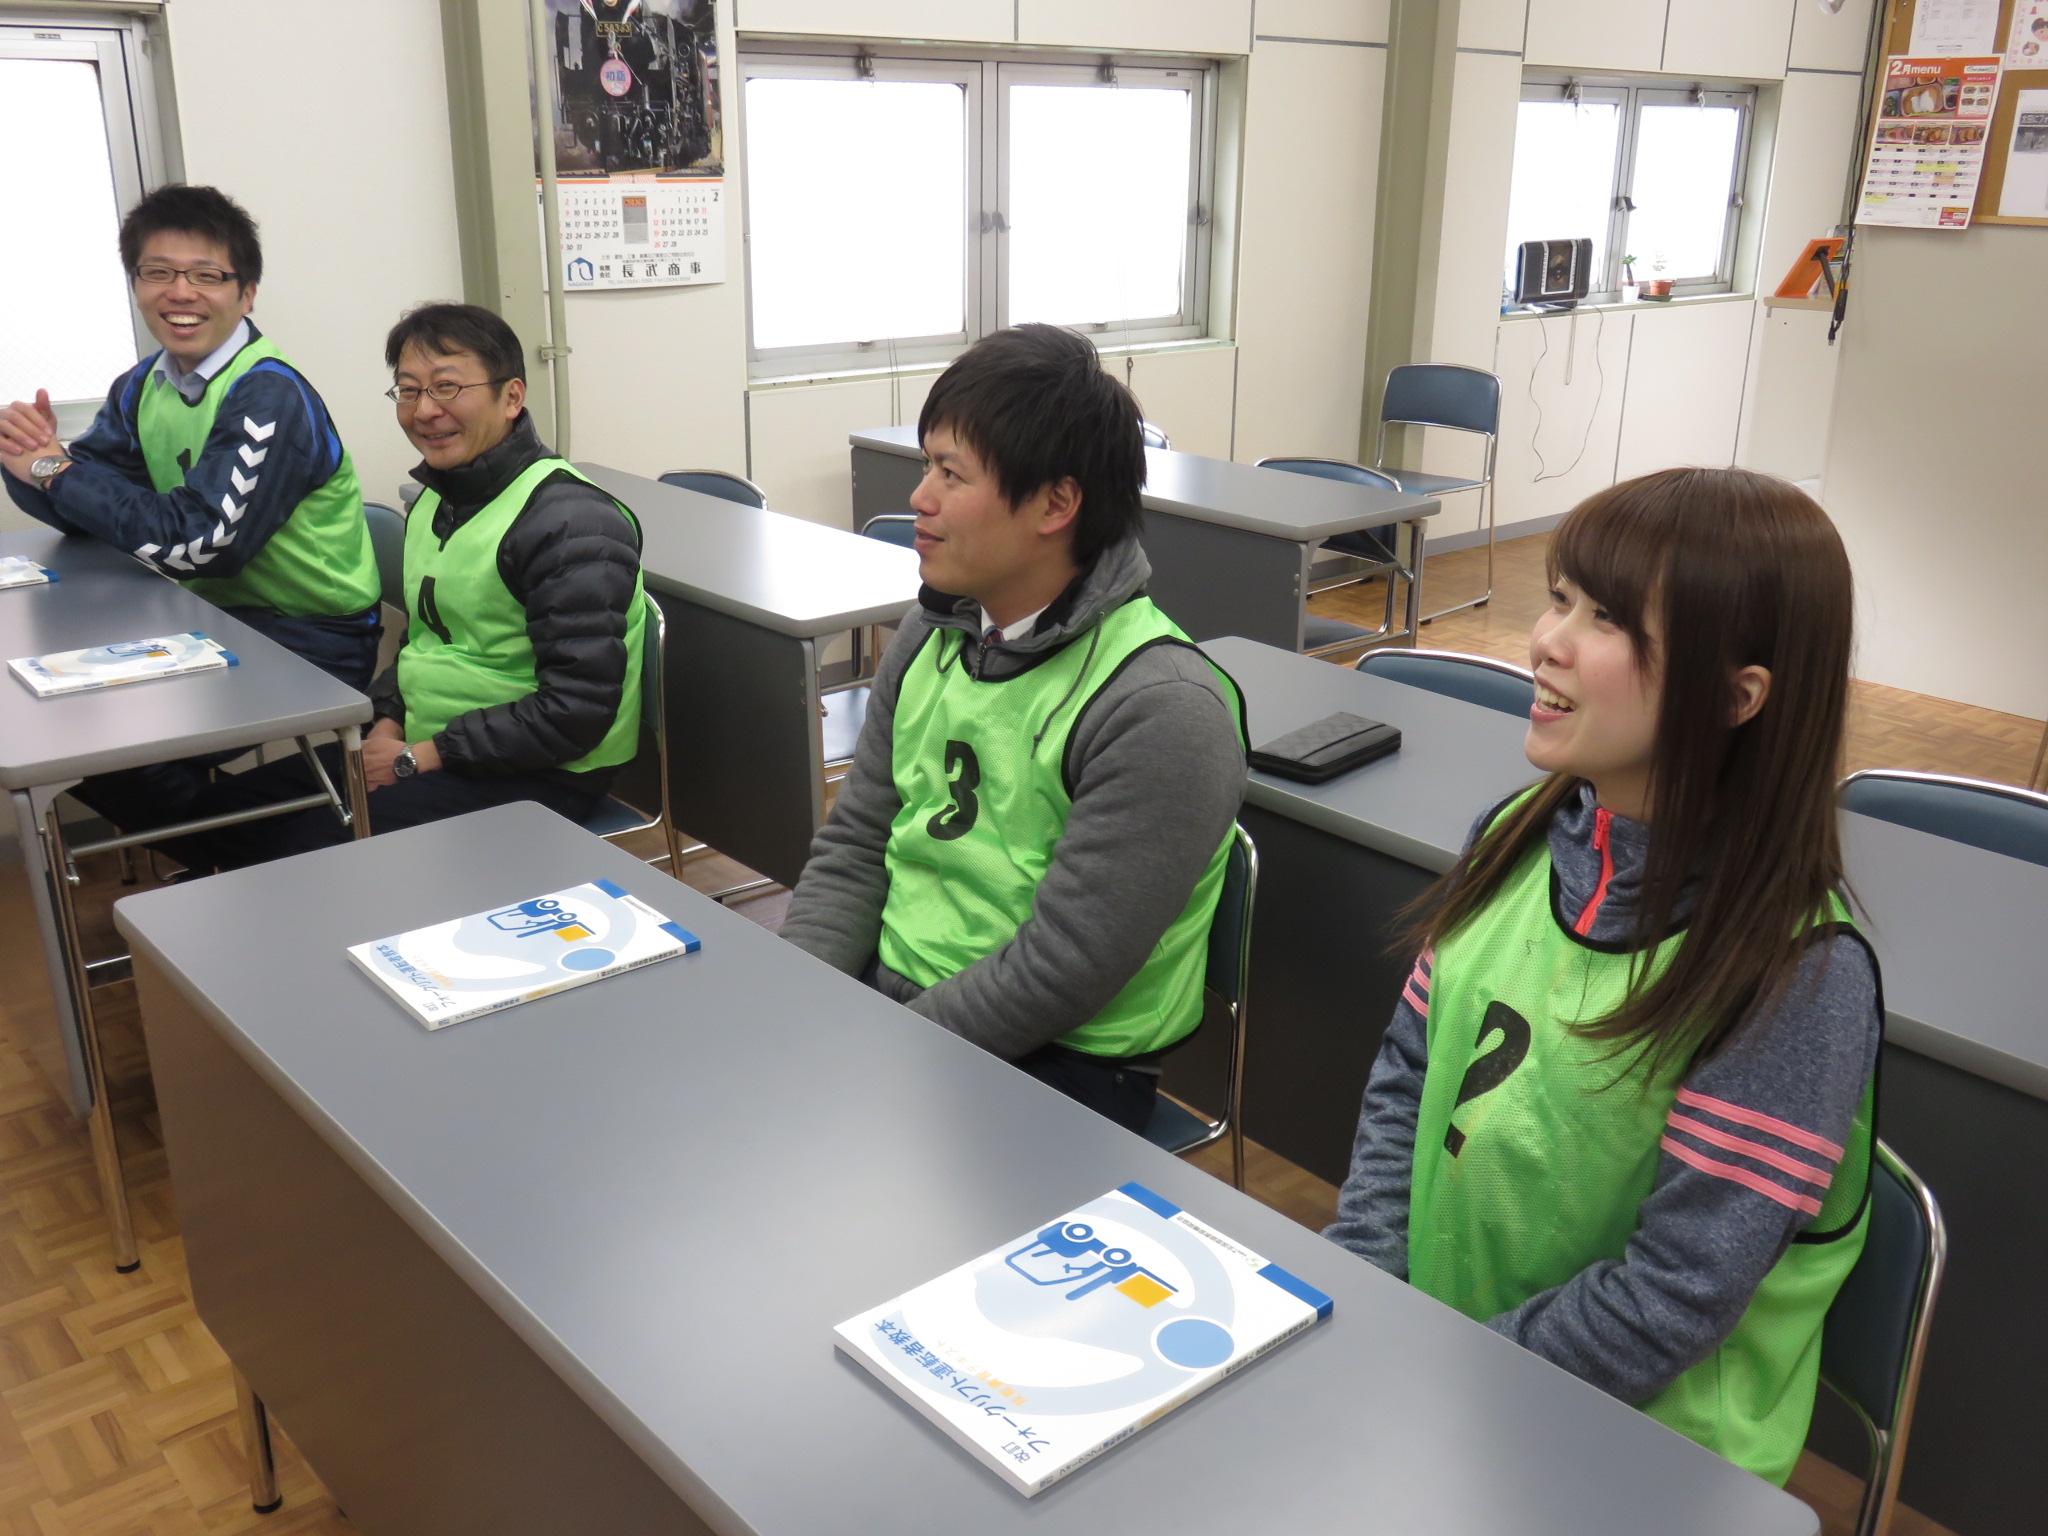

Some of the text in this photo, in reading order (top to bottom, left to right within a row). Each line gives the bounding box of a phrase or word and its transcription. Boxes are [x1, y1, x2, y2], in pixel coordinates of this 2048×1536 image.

[1890, 61, 1941, 75] 2月menu
[713, 191, 719, 202] 2
[622, 262, 701, 278] 長武商事
[418, 575, 453, 645] 4
[926, 740, 980, 841] 3
[1443, 1000, 1531, 1158] 2
[875, 1319, 1050, 1453] フォークリフト運転者教本
[1001, 1441, 1031, 1463] 改訂
